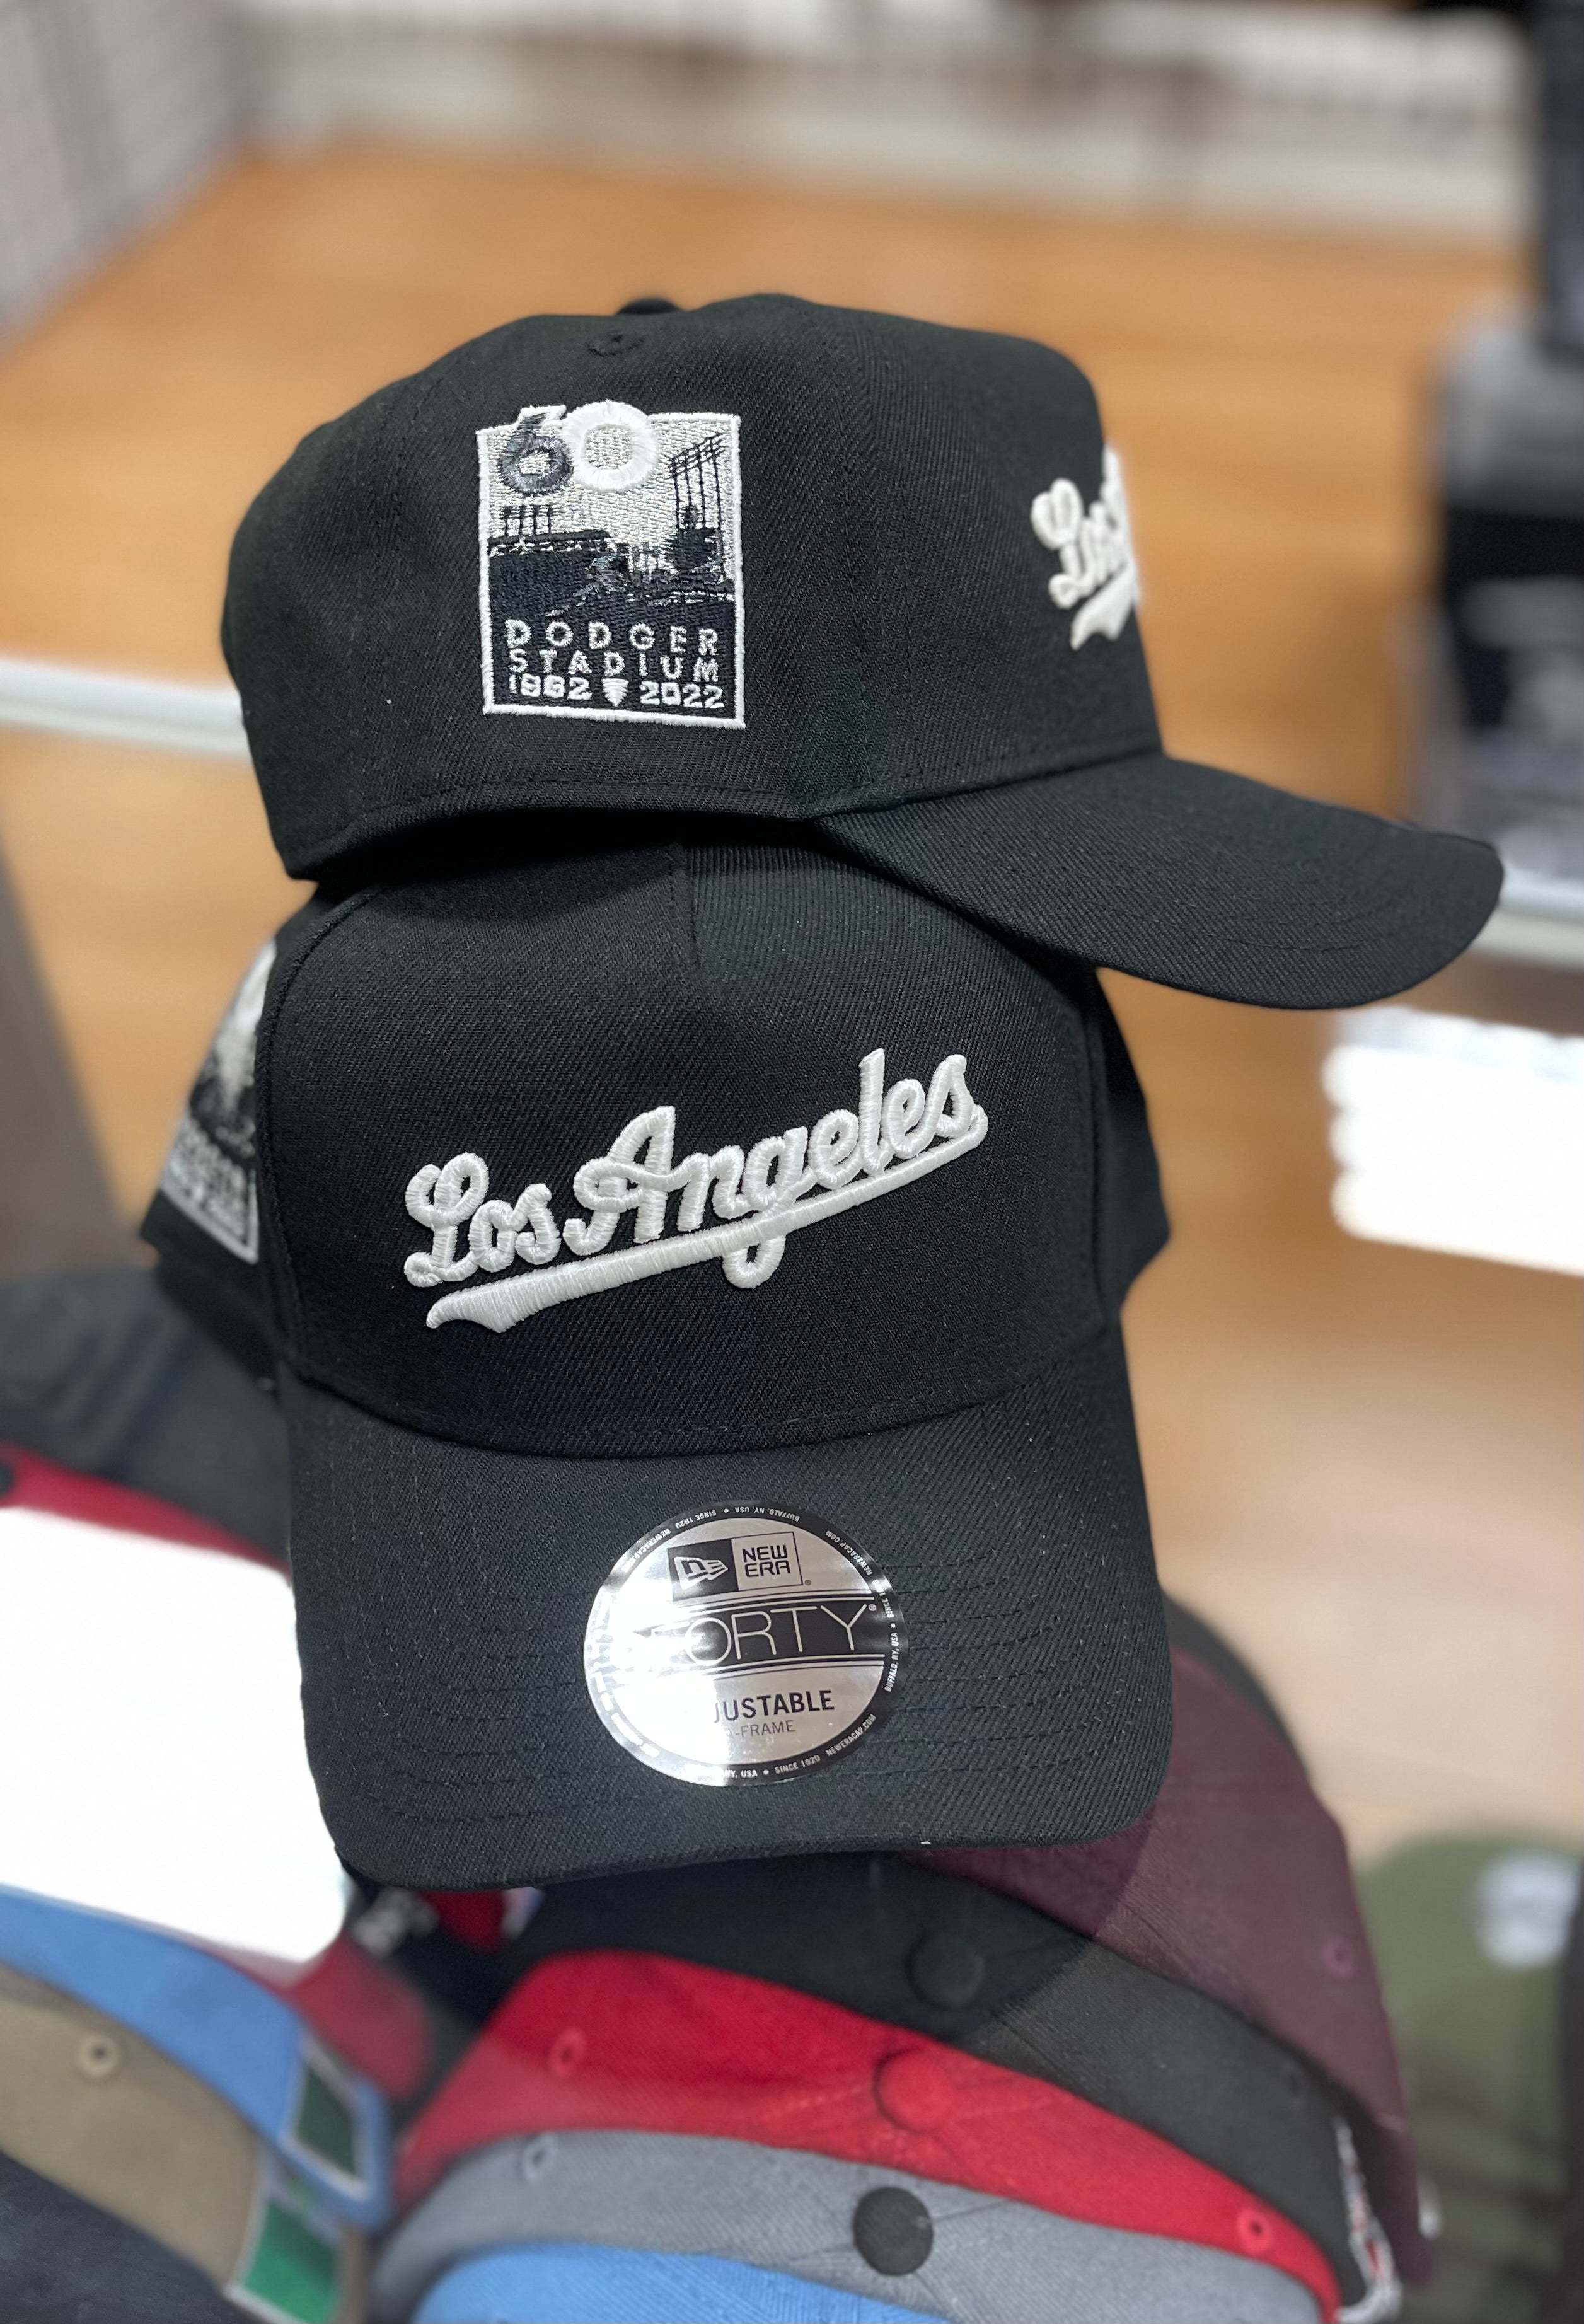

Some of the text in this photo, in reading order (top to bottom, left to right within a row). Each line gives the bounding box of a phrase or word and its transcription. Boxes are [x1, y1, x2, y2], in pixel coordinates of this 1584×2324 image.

[498, 399, 659, 497] 60
[505, 619, 719, 656] DODGER
[507, 648, 719, 683] STADIUM
[639, 681, 725, 709] 2022
[403, 1152, 561, 1288] Los
[562, 1047, 988, 1290] Angeles
[674, 1517, 693, 1529] 1920
[695, 1510, 717, 1521] SINCE
[621, 1528, 671, 1573] NEWERACAP.C
[743, 1544, 789, 1562] NEW
[825, 1530, 873, 1576] NEWERACAP.COM
[744, 1559, 792, 1578] ERA
[872, 1579, 886, 1597] 10
[651, 1603, 867, 1667] ORTY
[891, 1632, 899, 1646] USA
[714, 1689, 835, 1723] JUSTABLE
[741, 1769, 758, 1778] USA
[774, 1762, 799, 1774] SINCE
[801, 1754, 821, 1768] 1920
[825, 1713, 877, 1757] NEWERACAP.COM
